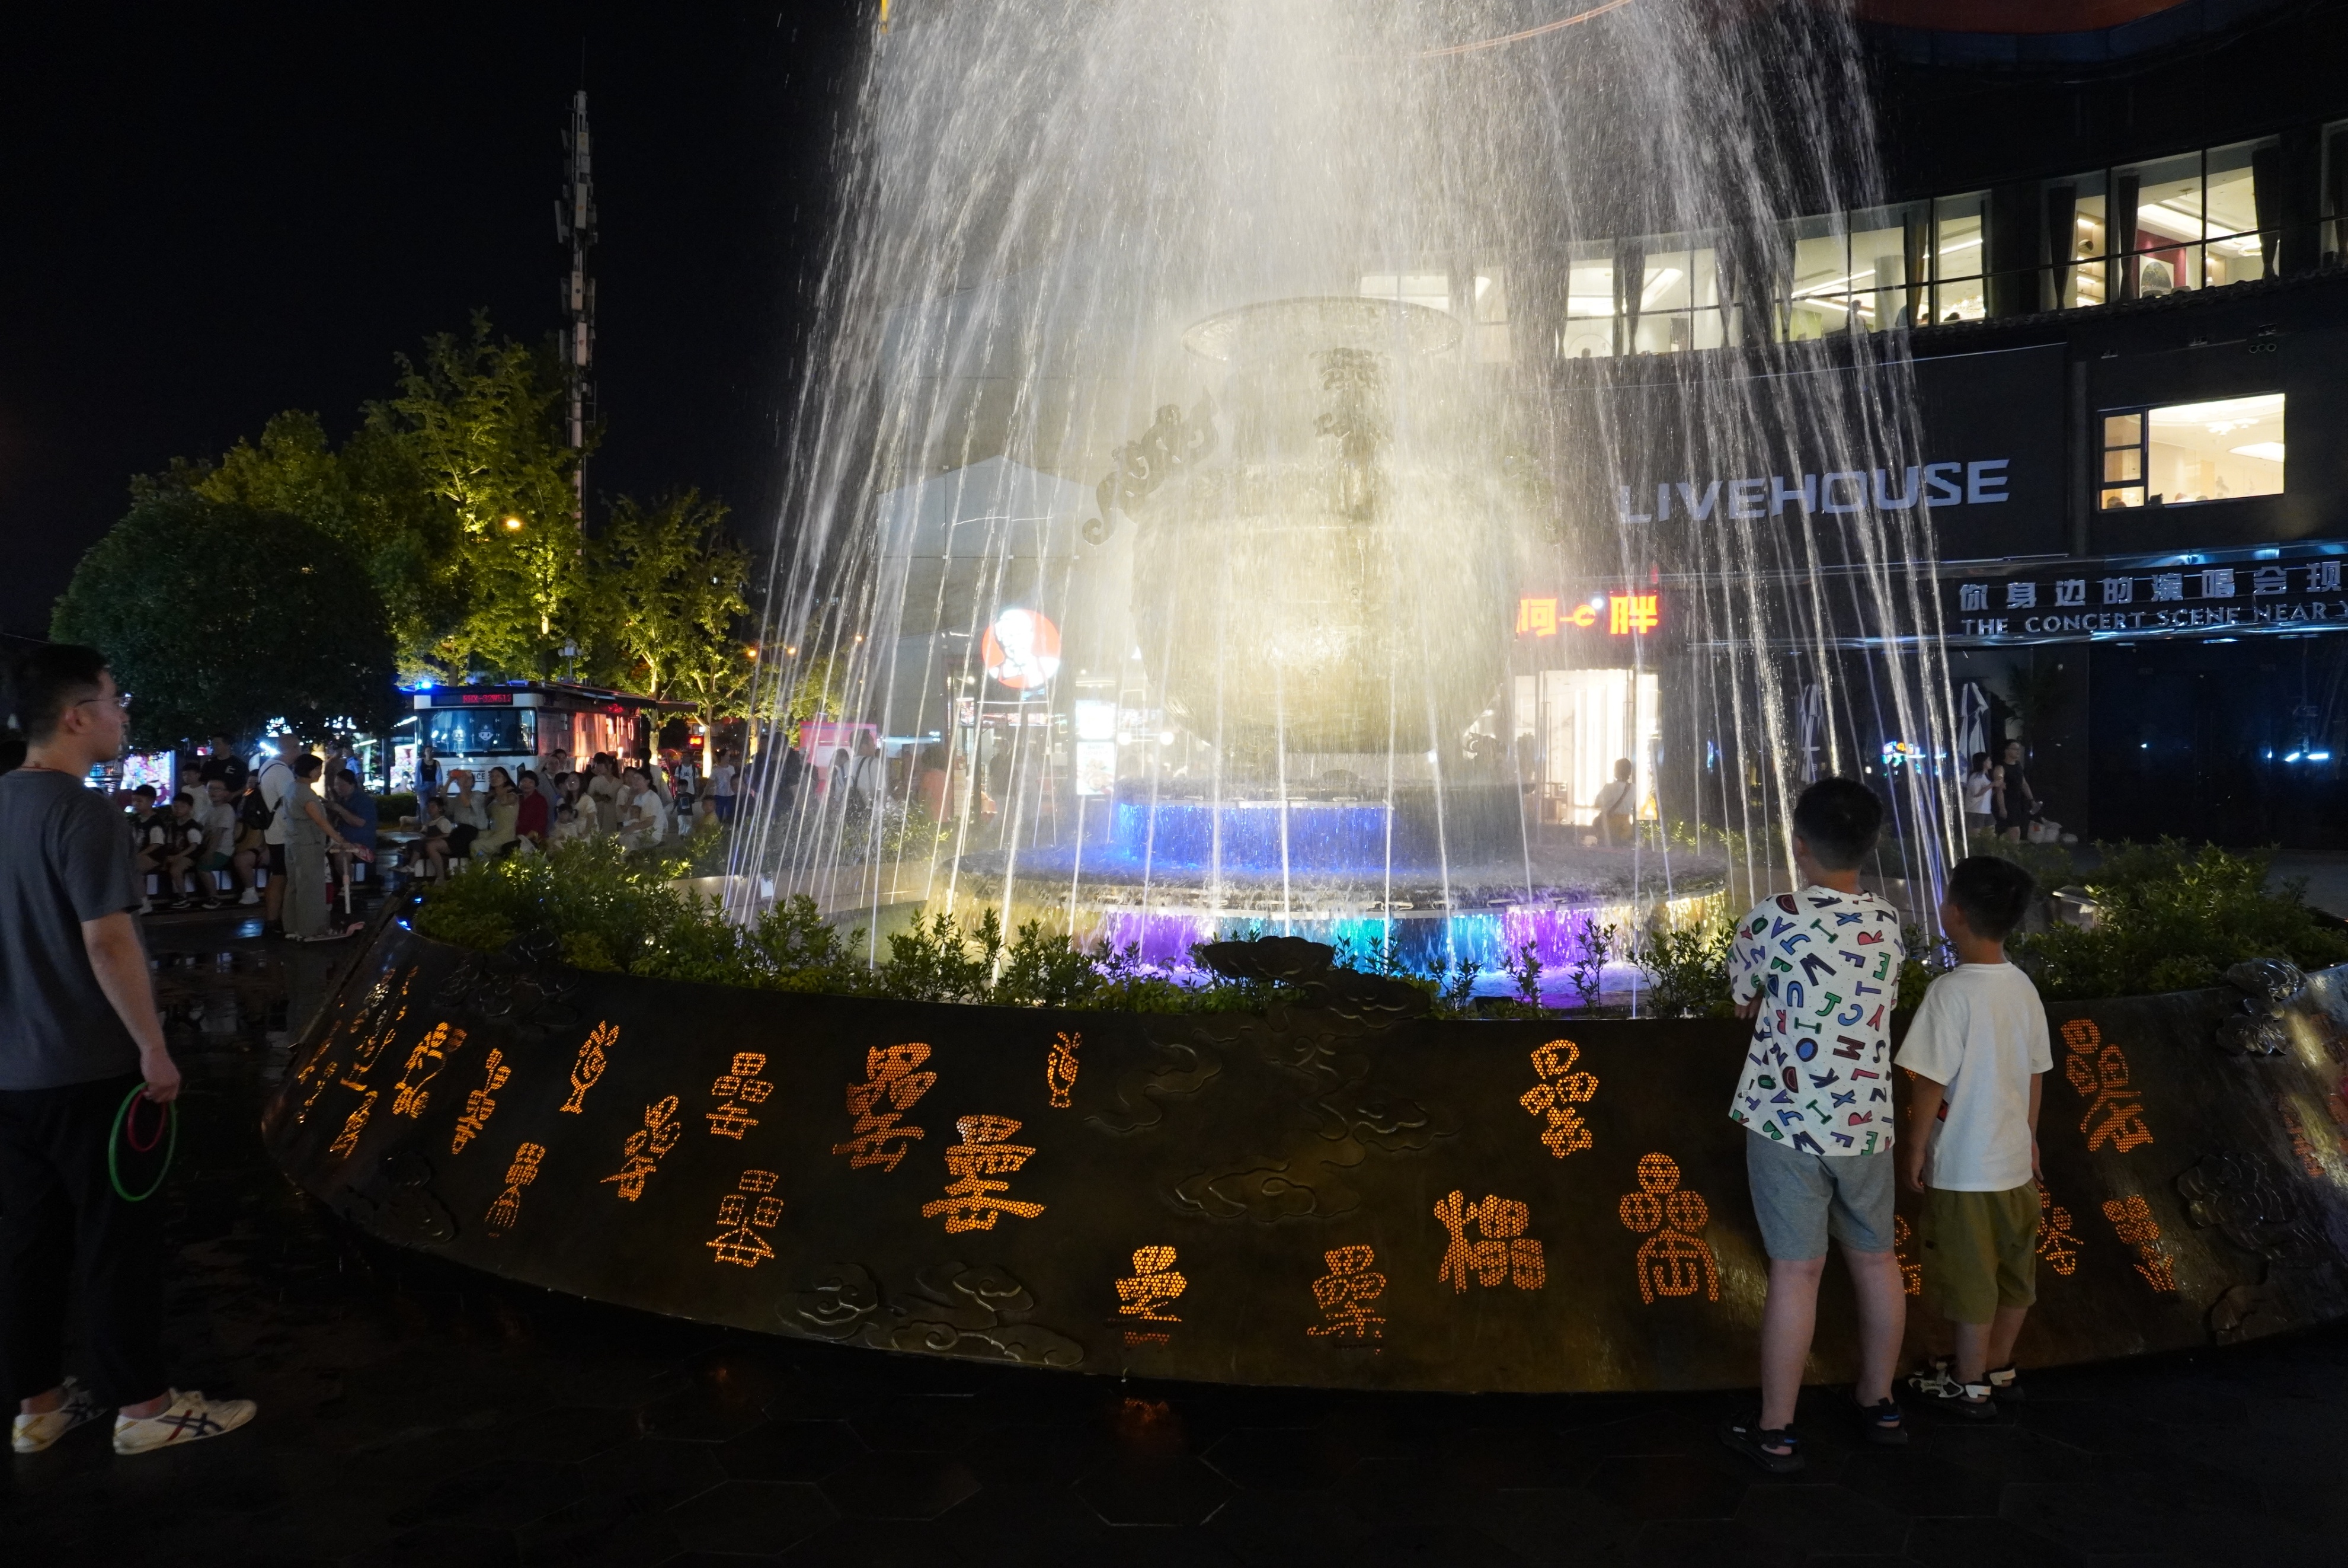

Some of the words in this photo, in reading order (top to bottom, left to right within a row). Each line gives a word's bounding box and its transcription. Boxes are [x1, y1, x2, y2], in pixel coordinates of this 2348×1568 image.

[1620, 459, 2010, 524] LIVEHOUSE
[1959, 561, 2341, 612] 你身边的演唱会现
[1962, 617, 2008, 636] THE
[2024, 611, 2147, 633] CONCERT
[2157, 607, 2241, 627] SCENE
[2254, 601, 2328, 623] NEAR
